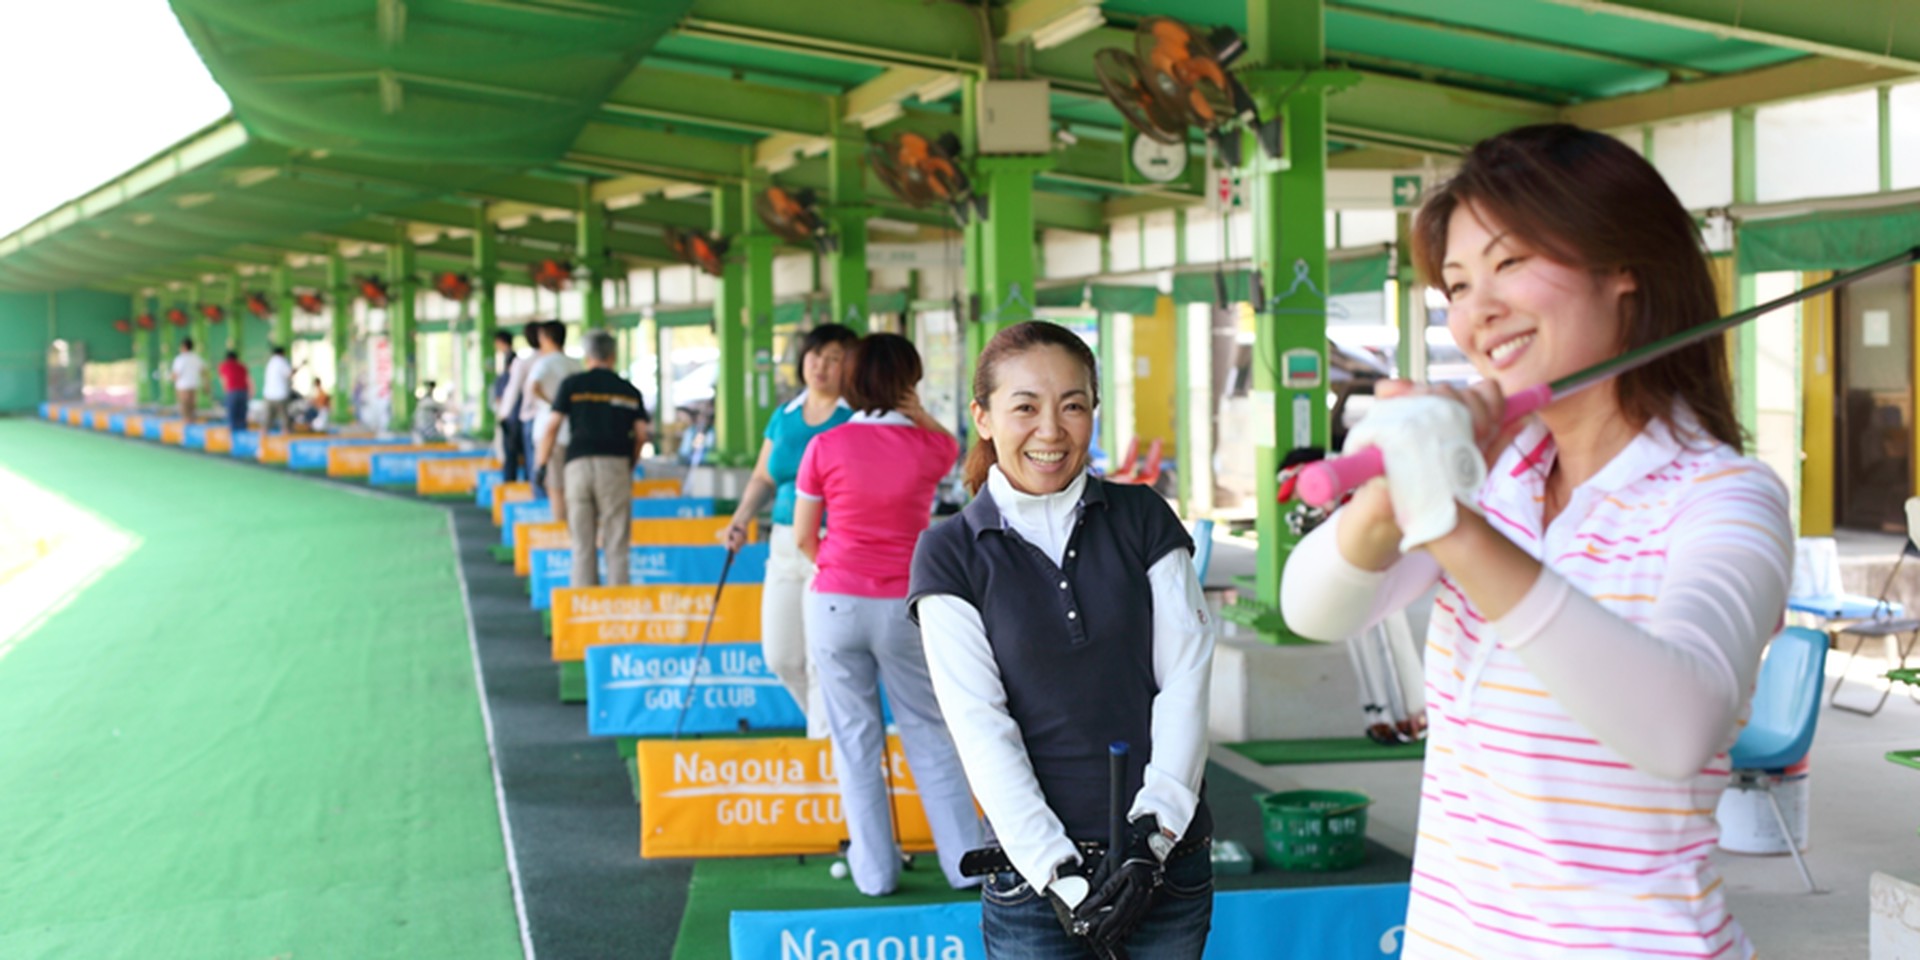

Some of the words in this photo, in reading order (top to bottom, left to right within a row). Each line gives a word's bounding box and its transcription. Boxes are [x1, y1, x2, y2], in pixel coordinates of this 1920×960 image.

[610, 653, 712, 681] Nagoya
[704, 686, 758, 708] CLUB
[672, 752, 805, 787] Nagoya
[716, 798, 785, 826] GOLF
[795, 798, 847, 825] CLU
[780, 928, 966, 960] Nagoya
